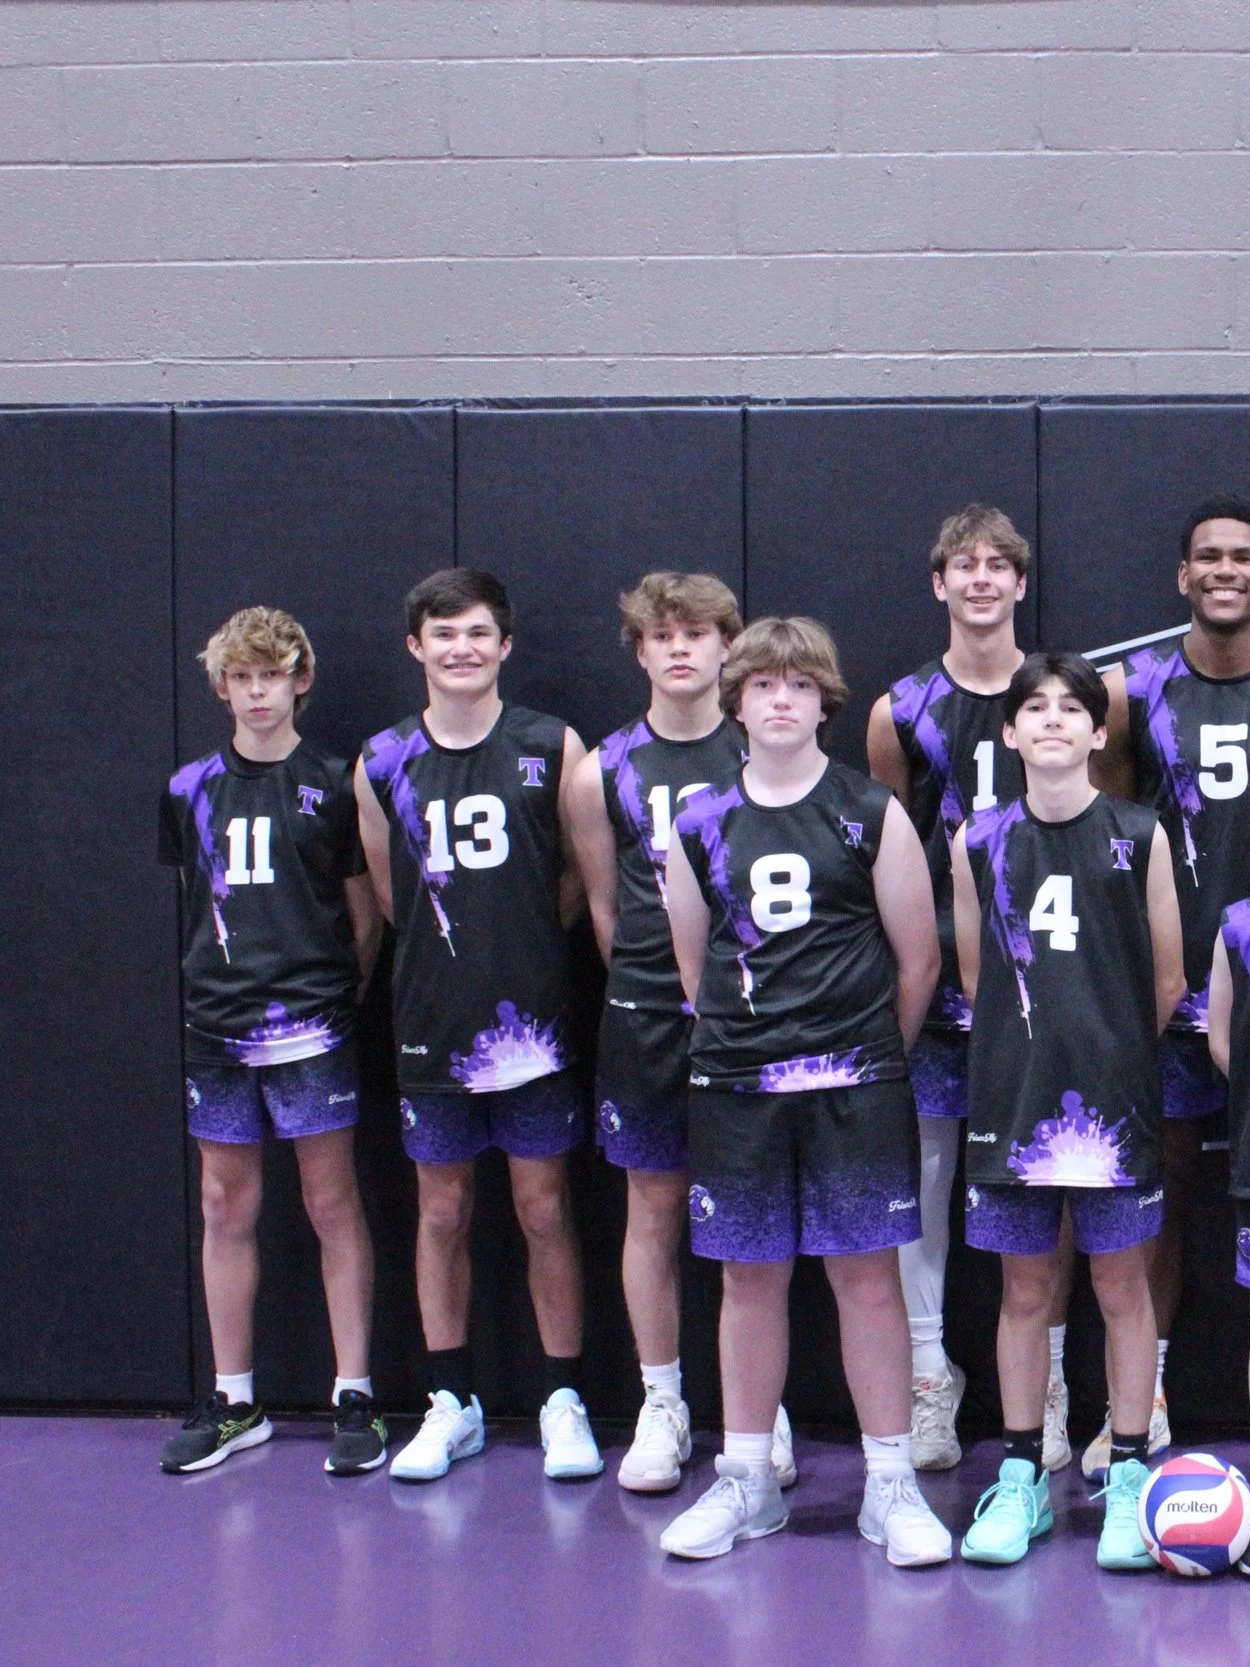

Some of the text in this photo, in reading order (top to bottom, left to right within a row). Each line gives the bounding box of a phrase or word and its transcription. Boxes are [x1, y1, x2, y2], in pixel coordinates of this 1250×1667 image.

[518, 757, 546, 787] T
[1198, 723, 1249, 800] 5
[298, 785, 324, 816] T
[424, 794, 510, 873] 13
[224, 816, 275, 885] 11
[1110, 838, 1134, 871] T
[750, 853, 812, 933] 8
[1029, 874, 1079, 951] 4
[1167, 1500, 1218, 1514] molten
